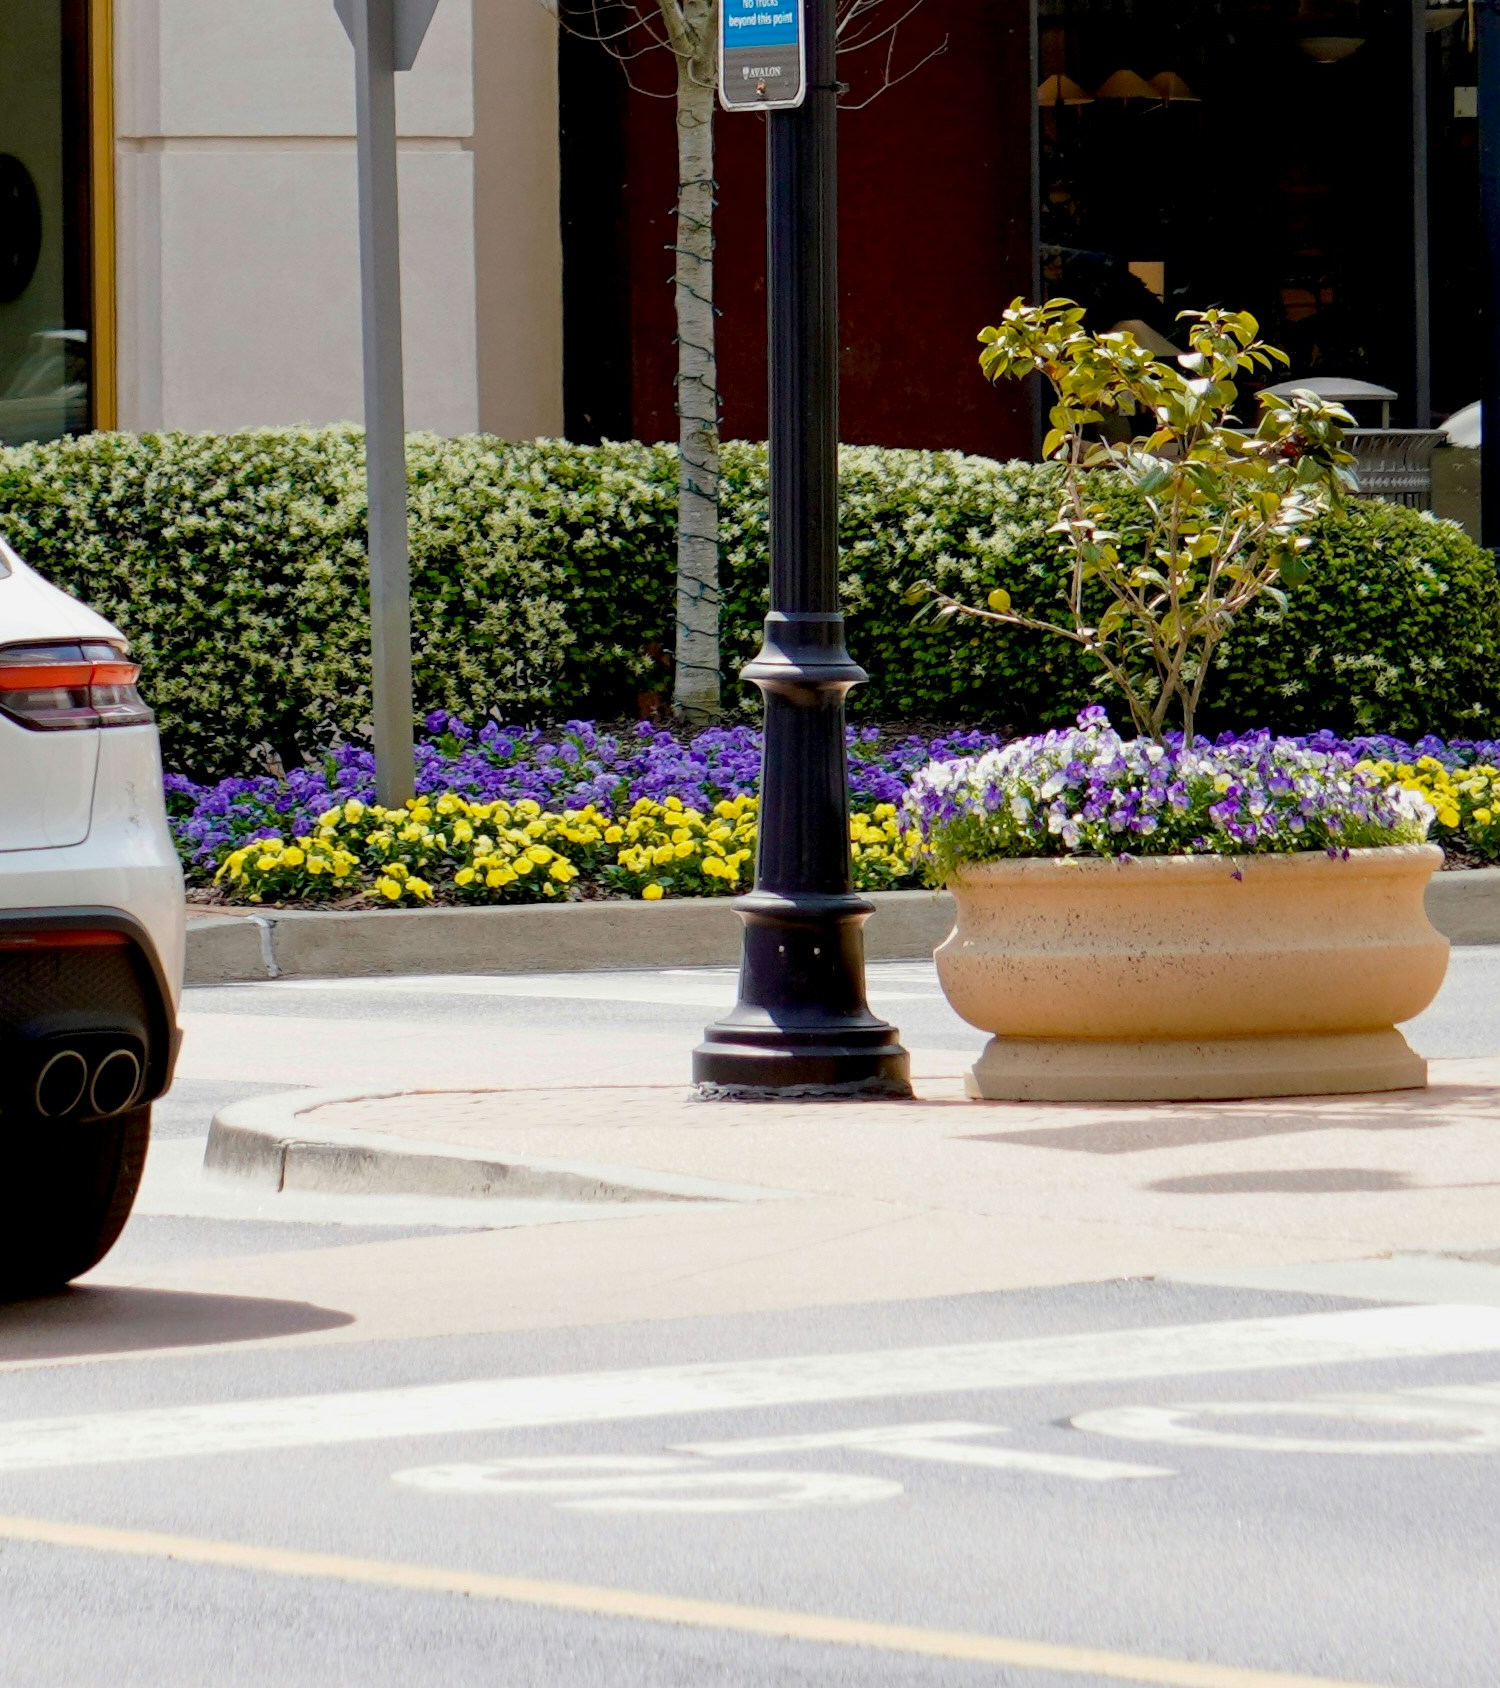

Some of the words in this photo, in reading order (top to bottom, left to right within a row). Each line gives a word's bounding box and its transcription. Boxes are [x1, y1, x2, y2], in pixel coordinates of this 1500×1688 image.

[728, 12, 757, 29] beyond
[757, 12, 772, 26] this
[772, 11, 793, 27] point
[749, 66, 782, 79] AVALON
